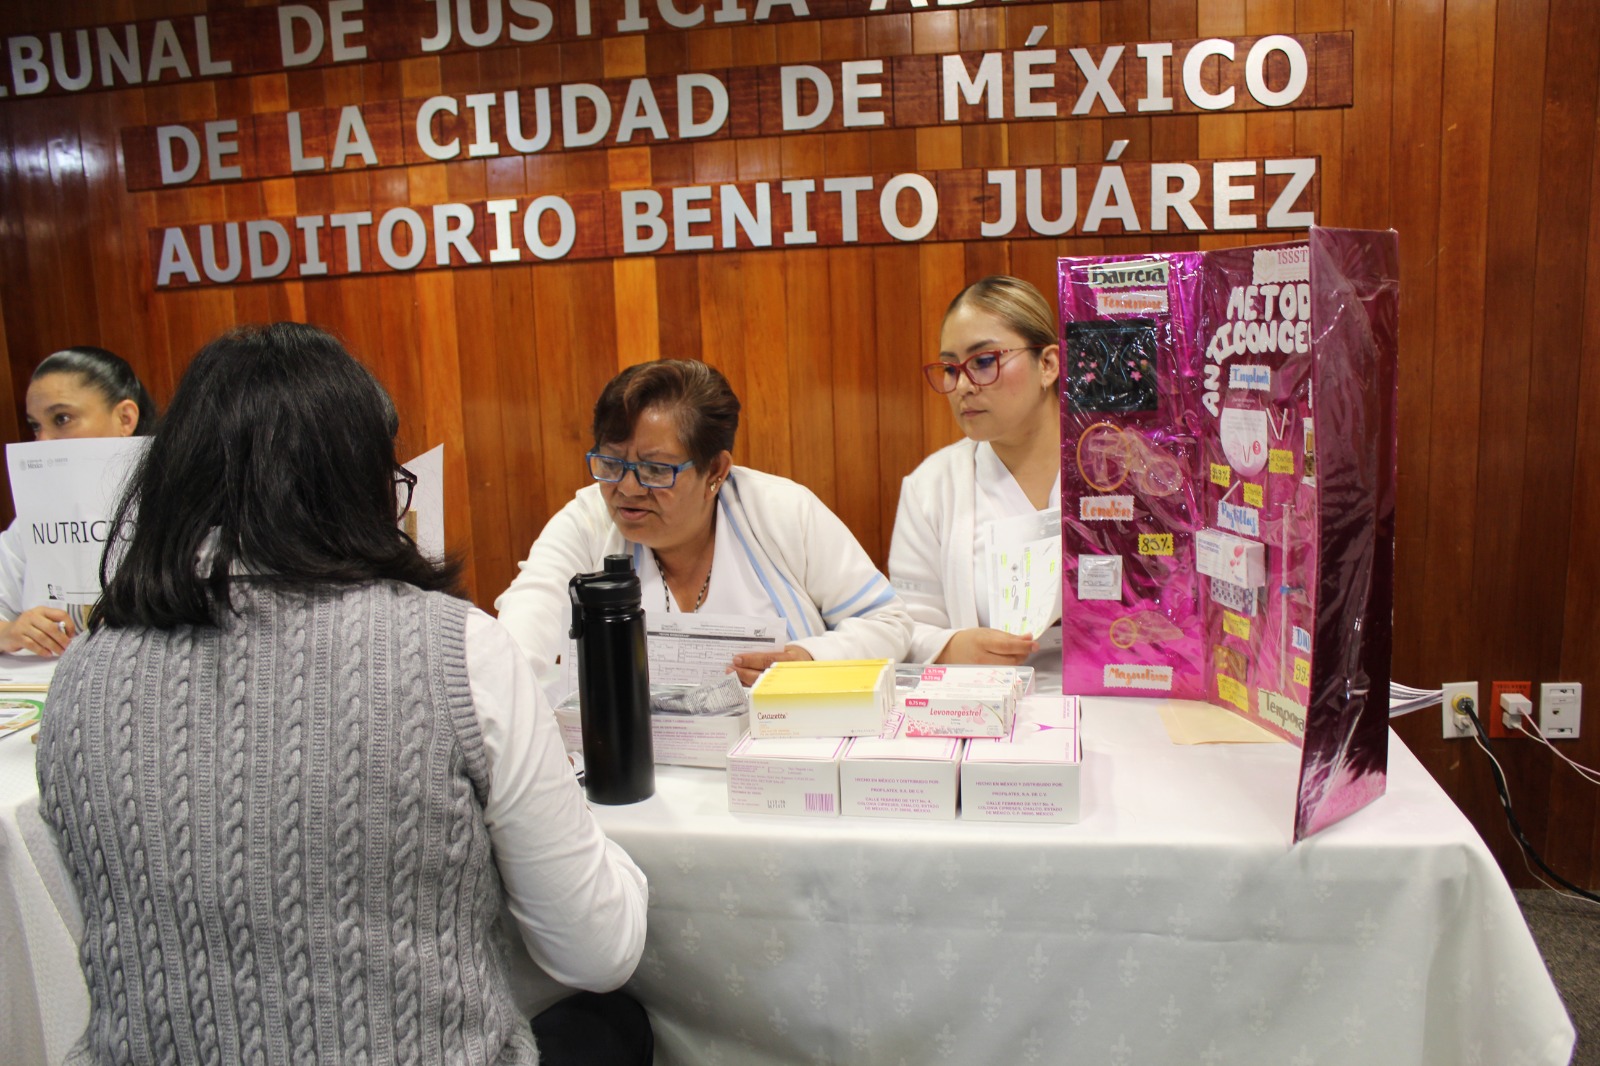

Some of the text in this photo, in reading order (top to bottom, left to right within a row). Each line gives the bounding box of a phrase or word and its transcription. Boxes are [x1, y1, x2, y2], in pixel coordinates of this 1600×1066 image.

[0, 17, 232, 96] BUNAL
[278, 0, 368, 68] DE
[156, 24, 1308, 186] DE LA CIUDAD DE MÉXICO
[156, 139, 1317, 286] AUDITORIO BENITO JUÁREZ
[1277, 250, 1308, 265] ISSST
[1226, 284, 1310, 322] METOD
[1202, 320, 1311, 417] ANTICONCE
[32, 520, 137, 545] NUTRICO
[757, 711, 787, 720] Cerazette
[930, 707, 982, 717] Levonorgestrel
